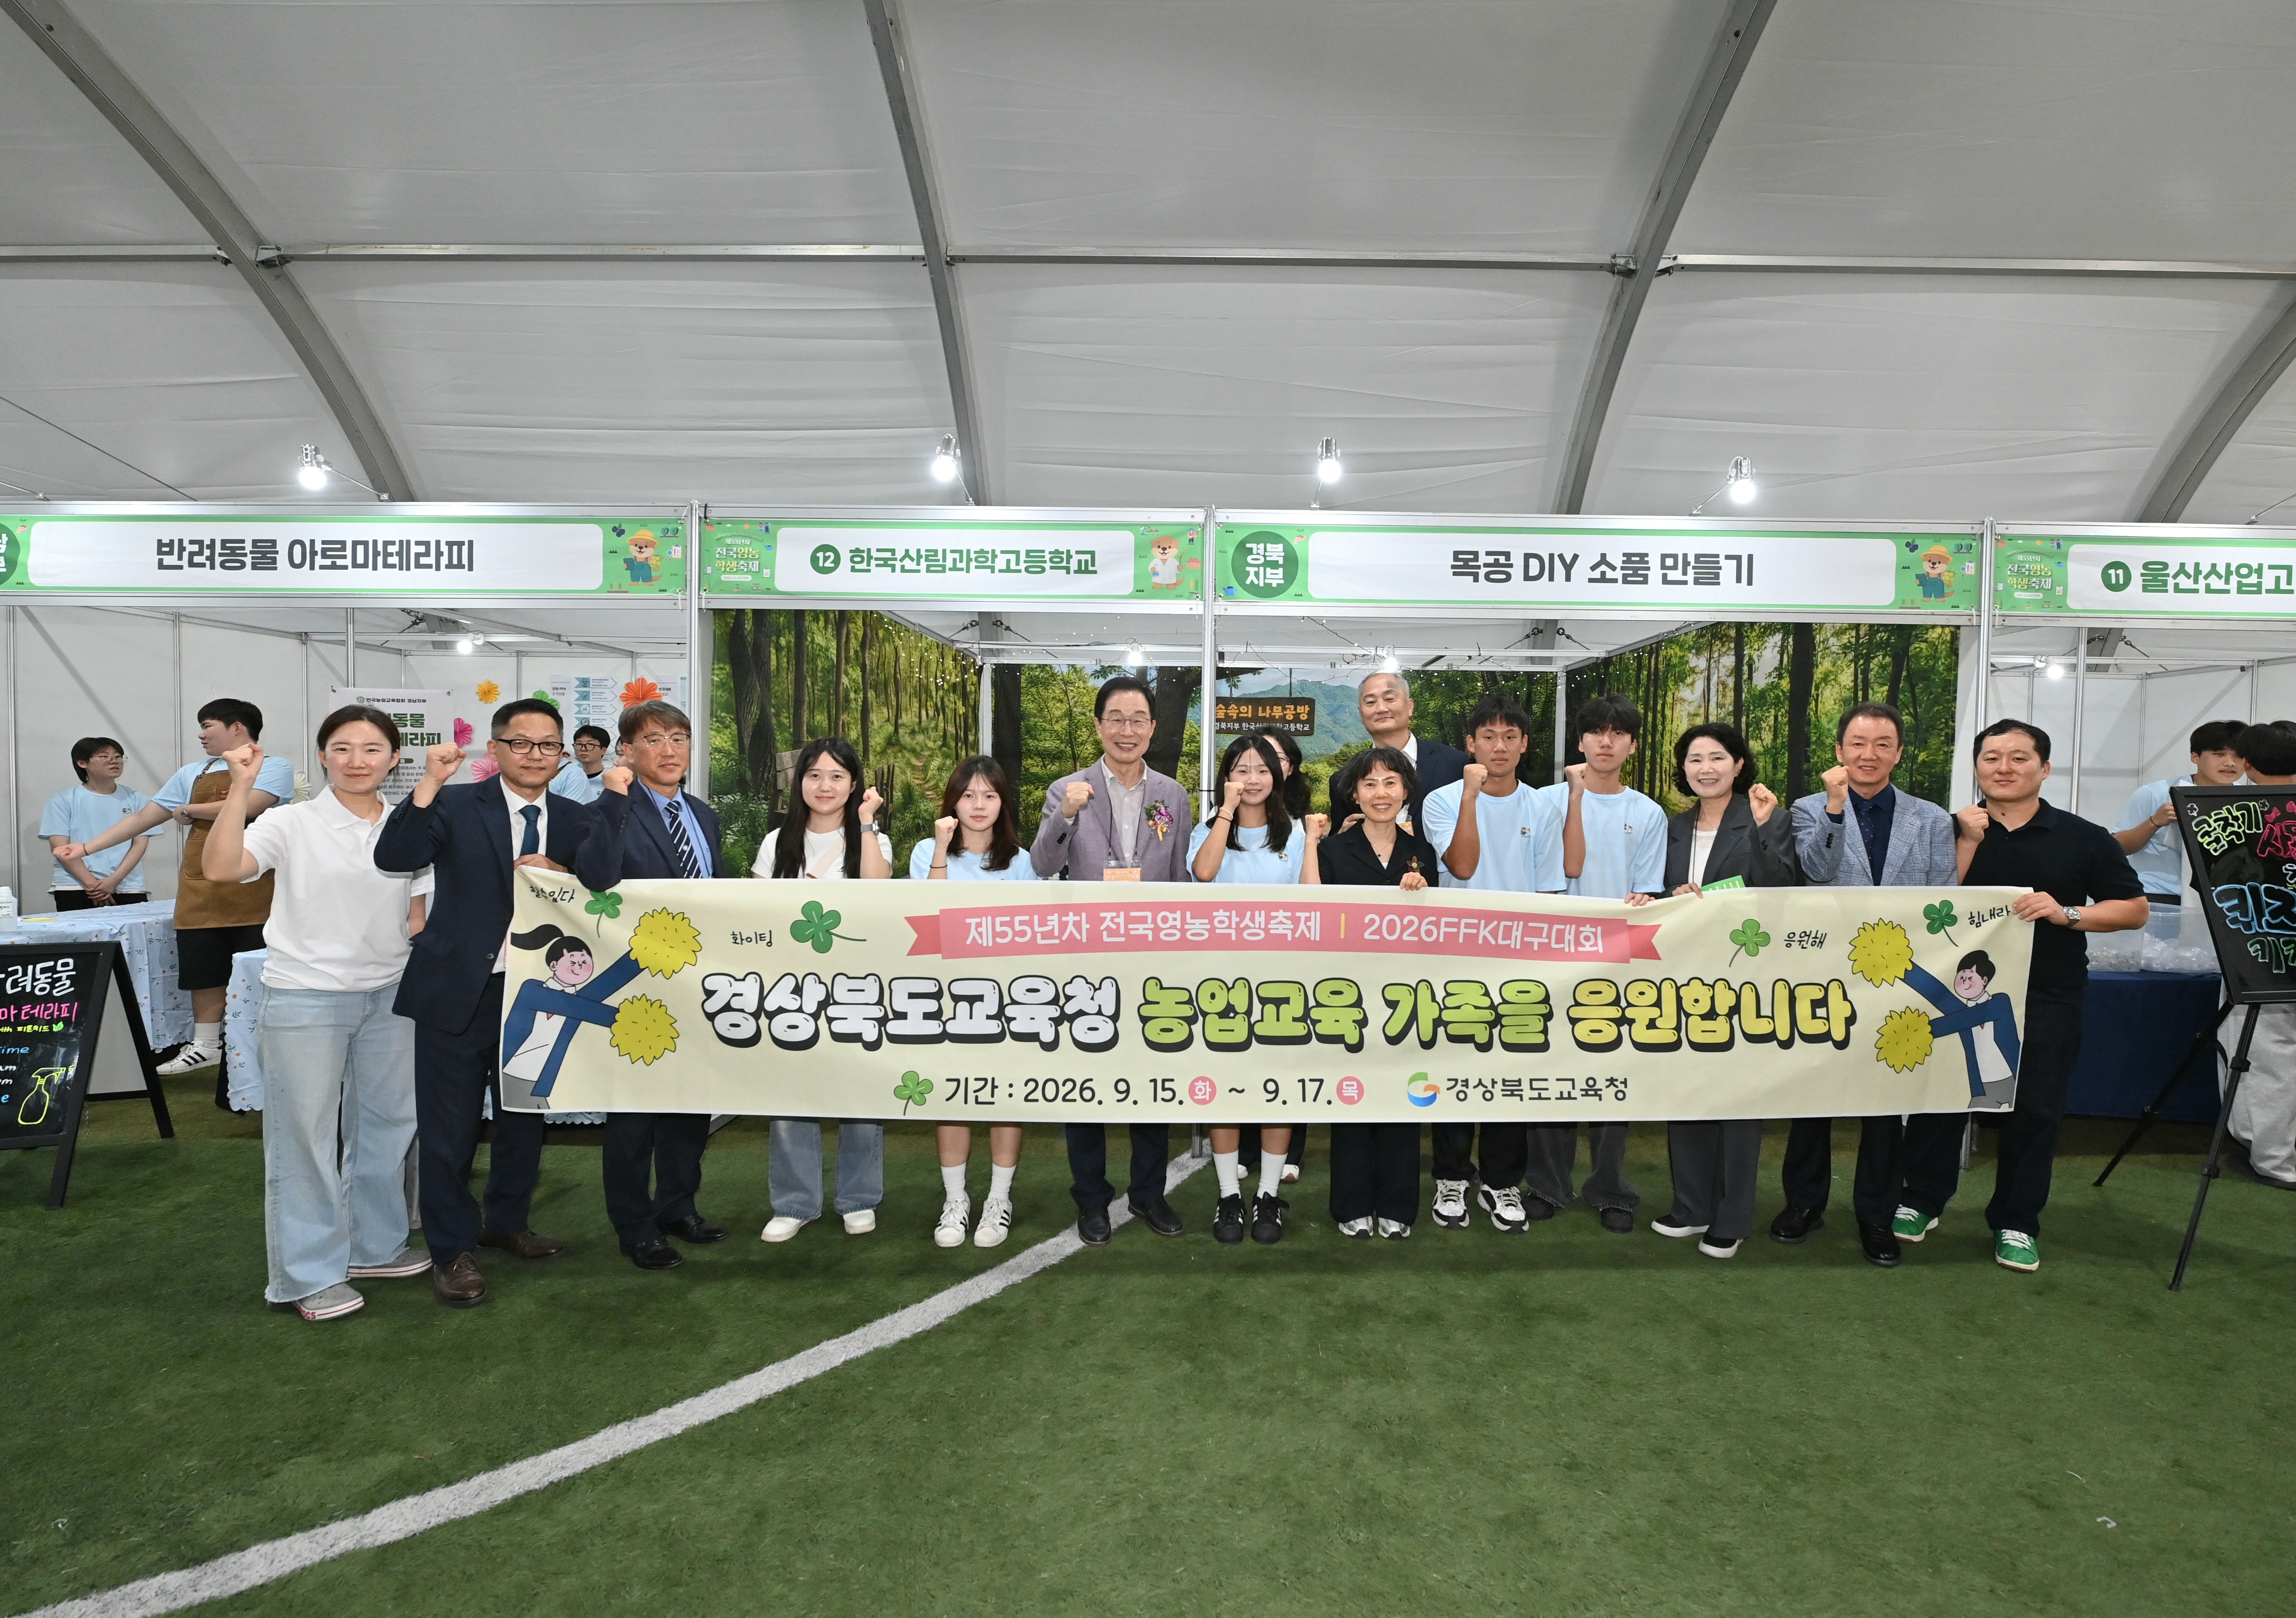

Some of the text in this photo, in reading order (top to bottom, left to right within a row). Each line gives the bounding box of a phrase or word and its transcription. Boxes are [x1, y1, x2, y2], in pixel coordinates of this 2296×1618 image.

[156, 538, 474, 572] 반려동물 아로마테라피
[715, 547, 760, 559] 전국영농
[816, 547, 1098, 575] 12 한국산림과학고등학교
[1245, 543, 1284, 564] 경북
[715, 560, 760, 572] 학생축제
[1450, 550, 1754, 586] 목공 DIY 소품 만들기
[2006, 564, 2052, 576] 전국영농
[1245, 567, 1284, 587] 지부
[2007, 578, 2052, 590] 학생축제
[2108, 561, 2295, 595] 11 울산산업고
[388, 713, 425, 728] 동물
[1216, 704, 1310, 720] 숲속의 나무공방
[1215, 721, 1240, 731] 경북지부
[1968, 904, 2011, 928] 힘내라
[730, 930, 773, 948] 화이팅
[965, 909, 1604, 954] 제55년차 전국영농학생축제 2026FFK대구대회
[1783, 929, 1828, 950] 응원해
[0, 958, 76, 996] 려동물
[701, 972, 1857, 1053] 경상북도교육청 농업교육 가족을 응원합니다
[945, 1076, 999, 1106] 기간
[1023, 1078, 1104, 1106] 2026.
[1114, 1078, 1138, 1106] 9.
[1149, 1078, 1184, 1106] 15.
[1193, 1080, 1213, 1102] 화
[1263, 1078, 1288, 1106] 9.
[1297, 1078, 1332, 1106] 17.
[1341, 1080, 1359, 1102] 목
[1446, 1076, 1629, 1104] 경상북도교육청
